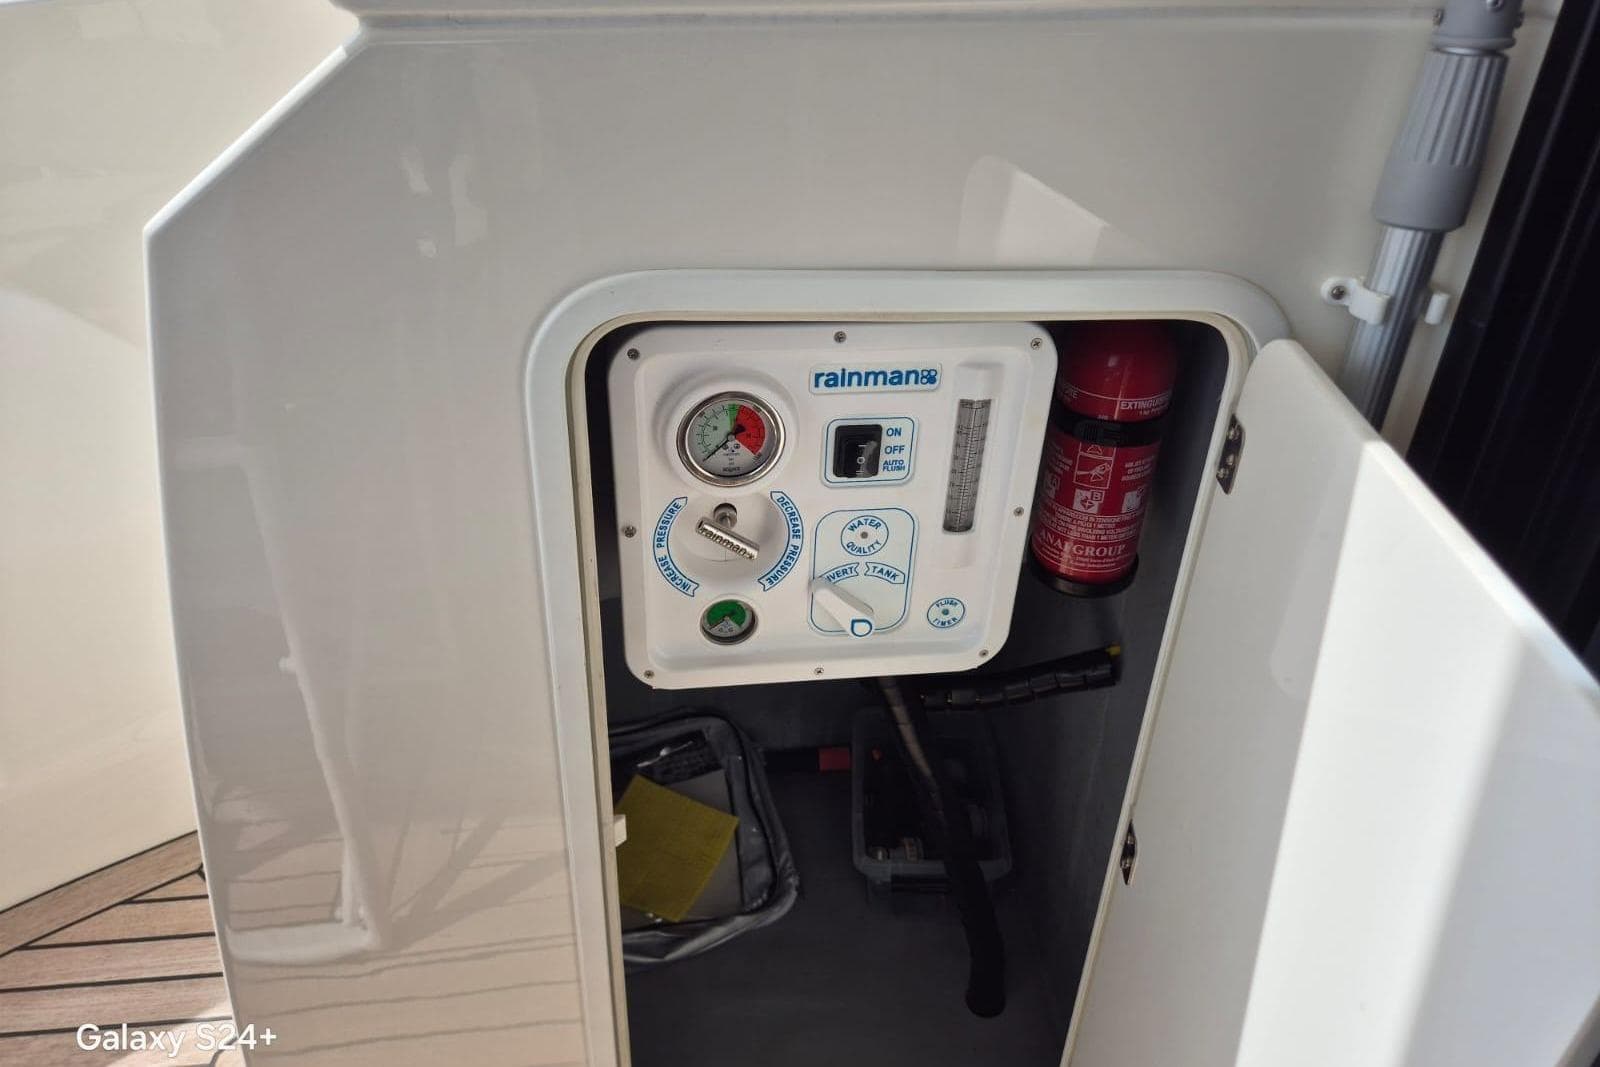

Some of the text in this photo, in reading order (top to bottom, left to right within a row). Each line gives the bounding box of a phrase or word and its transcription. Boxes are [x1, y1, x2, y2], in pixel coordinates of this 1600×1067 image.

[814, 368, 919, 388] rainman
[886, 427, 902, 437] ON
[884, 445, 905, 455] OFF
[847, 518, 882, 533] WATER
[656, 501, 691, 592] INCREASE PRESSURE
[700, 526, 747, 559] rainman
[766, 496, 801, 586] DECREASE PRESSURE
[846, 539, 882, 554] QUALITY
[826, 565, 854, 583] IVERT
[871, 565, 899, 582] TANK
[932, 616, 957, 627] TIMER
